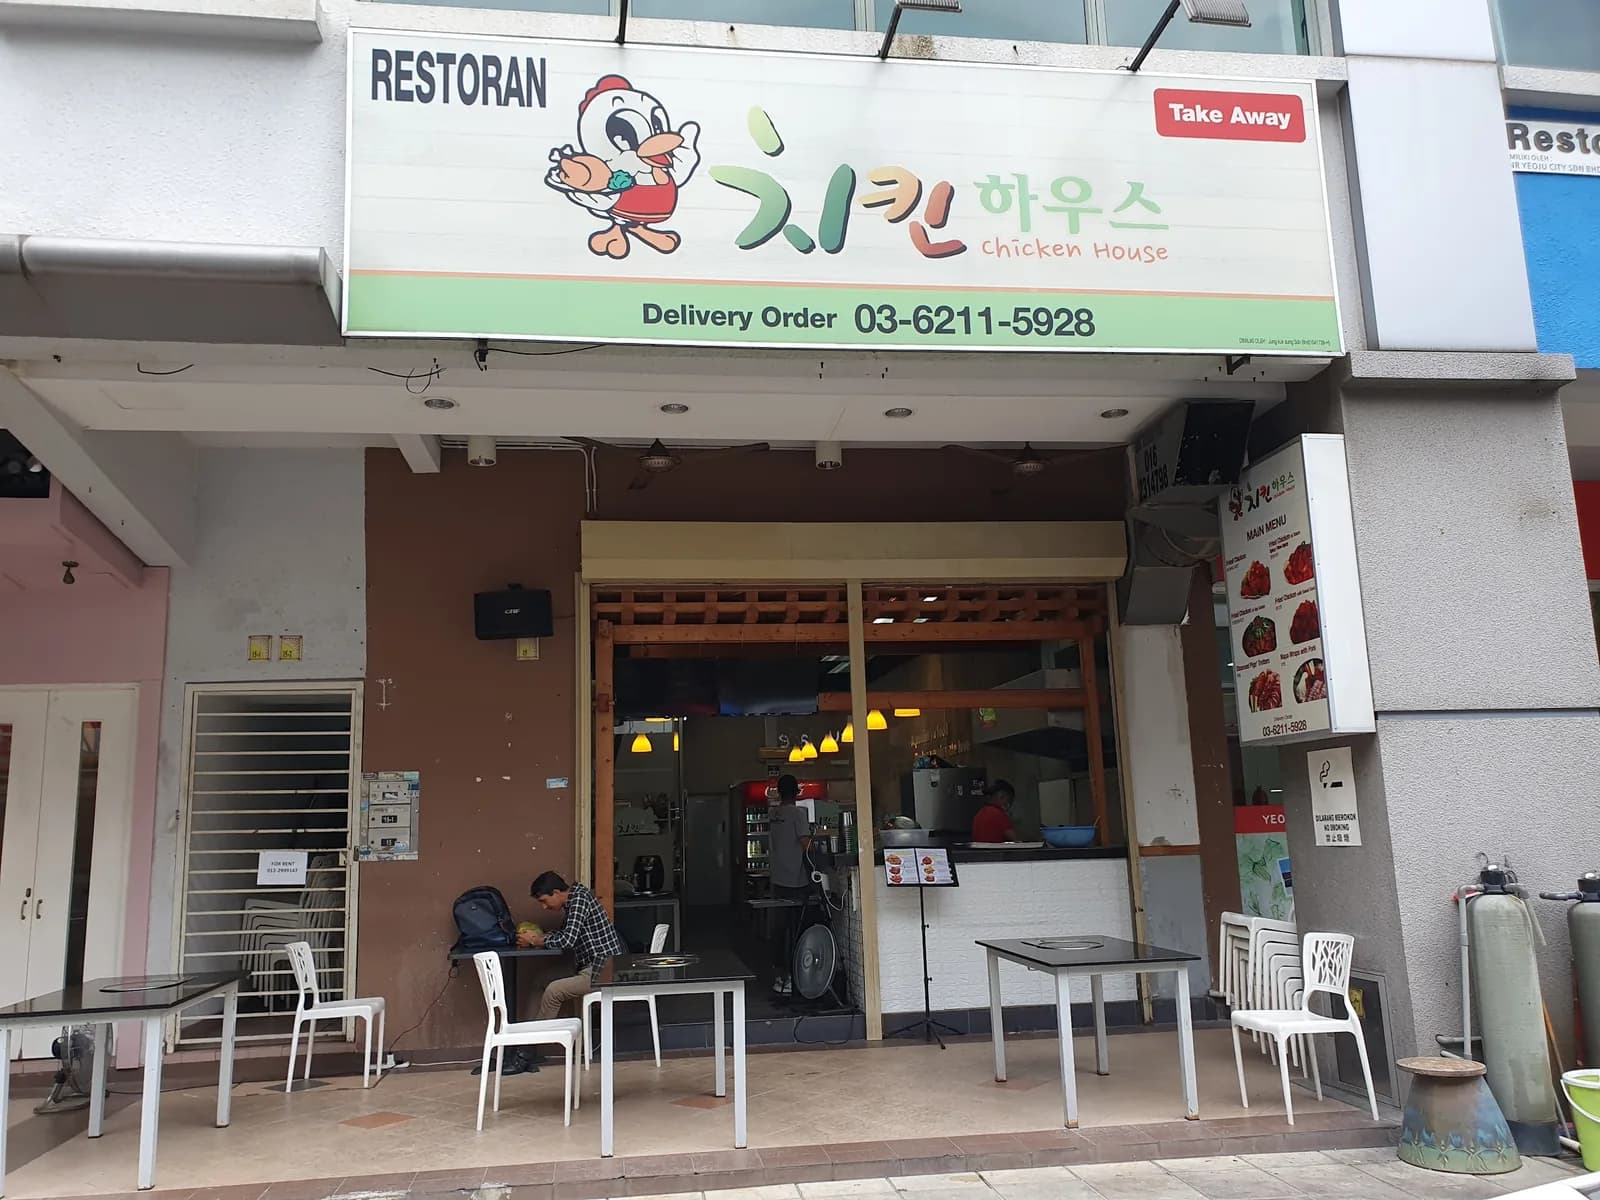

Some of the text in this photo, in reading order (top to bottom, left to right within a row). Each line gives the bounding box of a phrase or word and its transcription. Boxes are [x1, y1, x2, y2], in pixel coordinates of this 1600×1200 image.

[371, 48, 547, 108] RESTORAN
[1168, 102, 1292, 130] Take Away
[708, 104, 1170, 259] 치킨 하우스
[1094, 241, 1169, 264] House
[642, 303, 1097, 337] Delivery Order 03-6211-5928
[1265, 513, 1287, 533] MENU
[1262, 719, 1307, 737] 03-6211-5928
[1262, 814, 1285, 824] YEO
